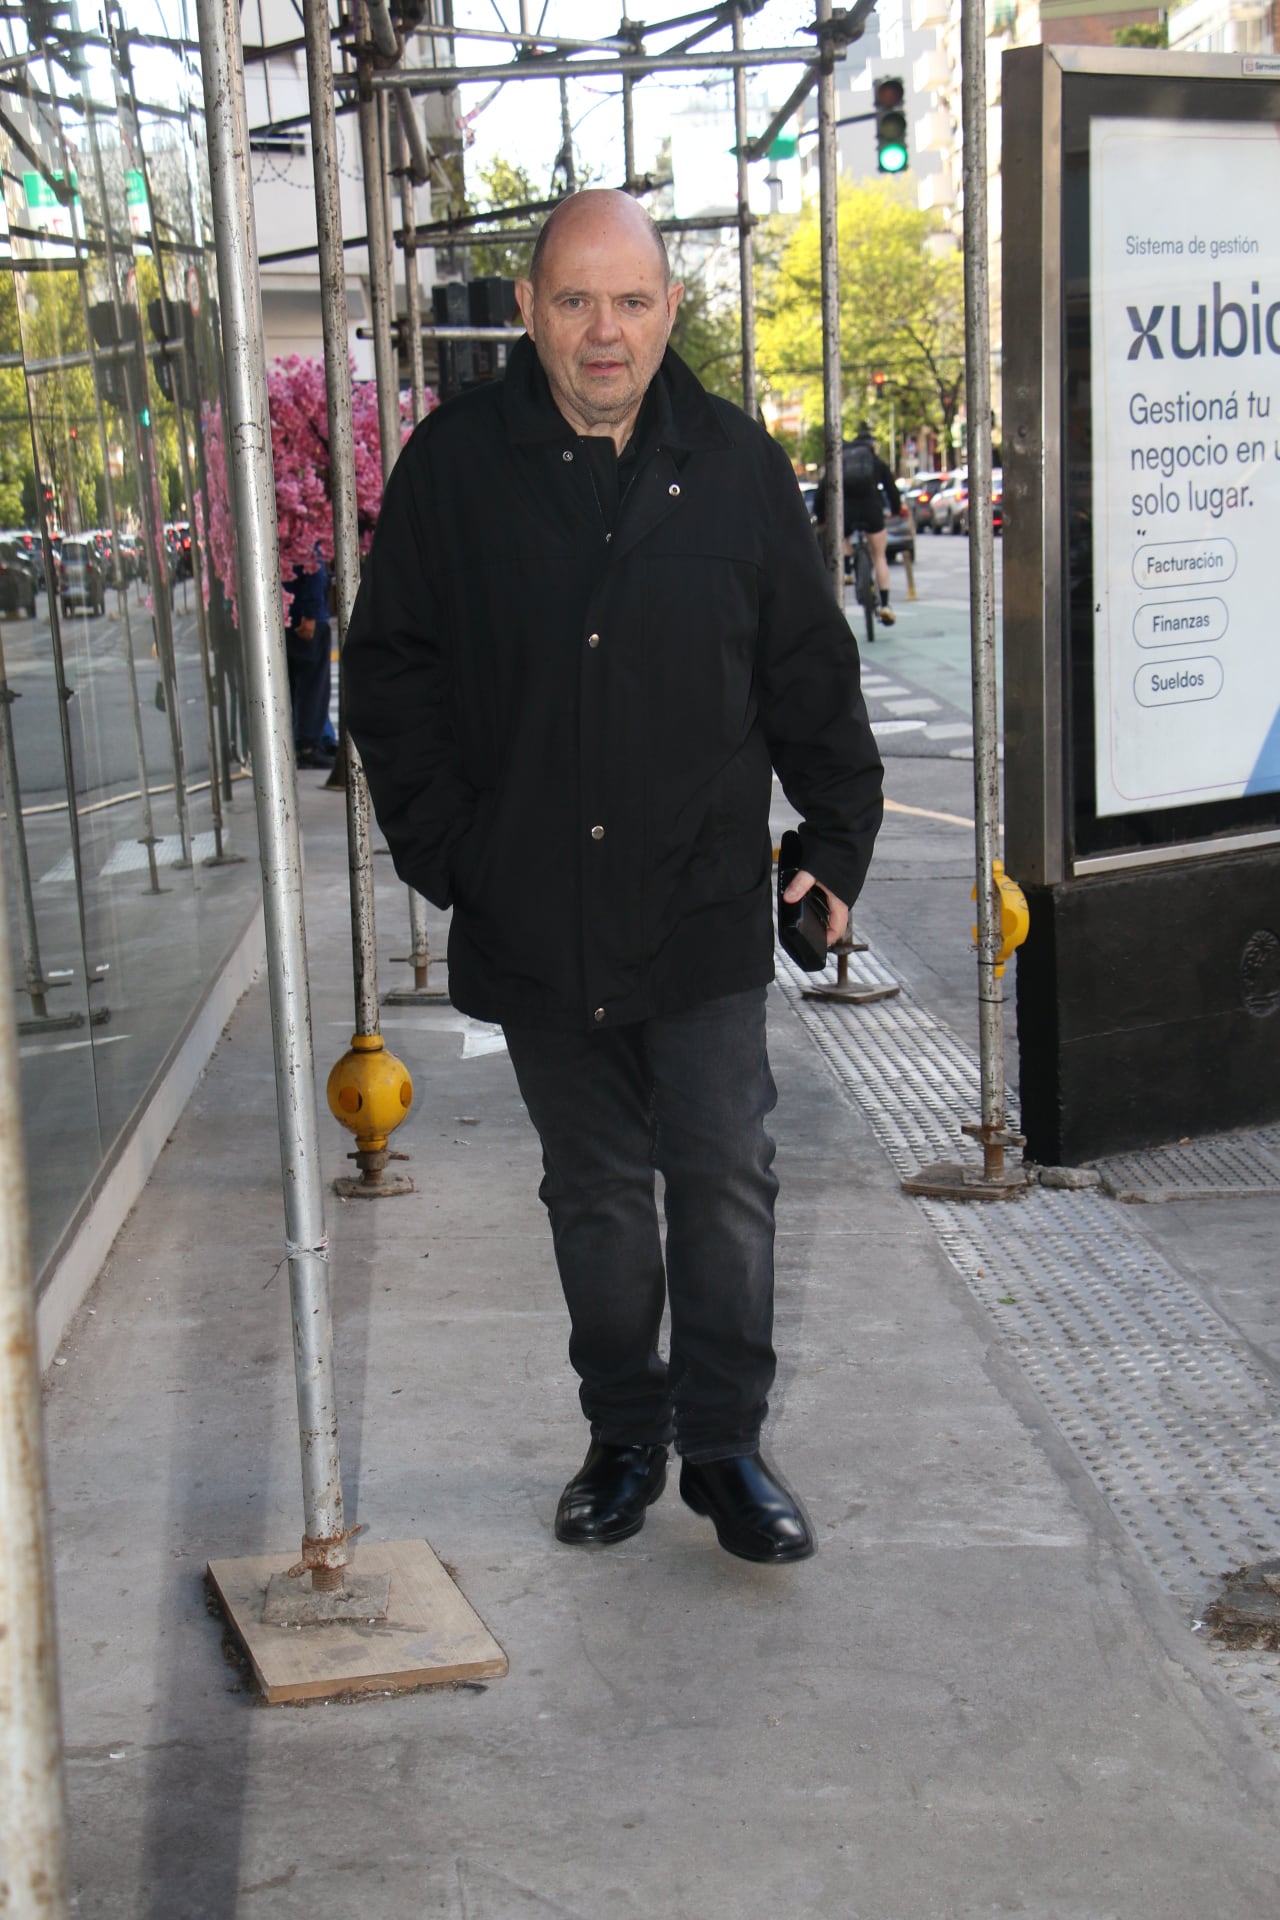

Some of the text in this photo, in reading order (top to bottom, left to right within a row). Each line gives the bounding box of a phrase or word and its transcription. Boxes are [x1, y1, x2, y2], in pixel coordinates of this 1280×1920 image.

[1126, 235, 1259, 259] Sistema de gestión
[1129, 390, 1270, 425] Gestioná tu
[1131, 435, 1228, 477] negocio
[1236, 440, 1265, 463] en
[1132, 480, 1254, 519] solo lugar.
[1147, 552, 1223, 575] Facturación
[1153, 614, 1210, 633] Finanzas
[1151, 671, 1204, 692] Sueldos
